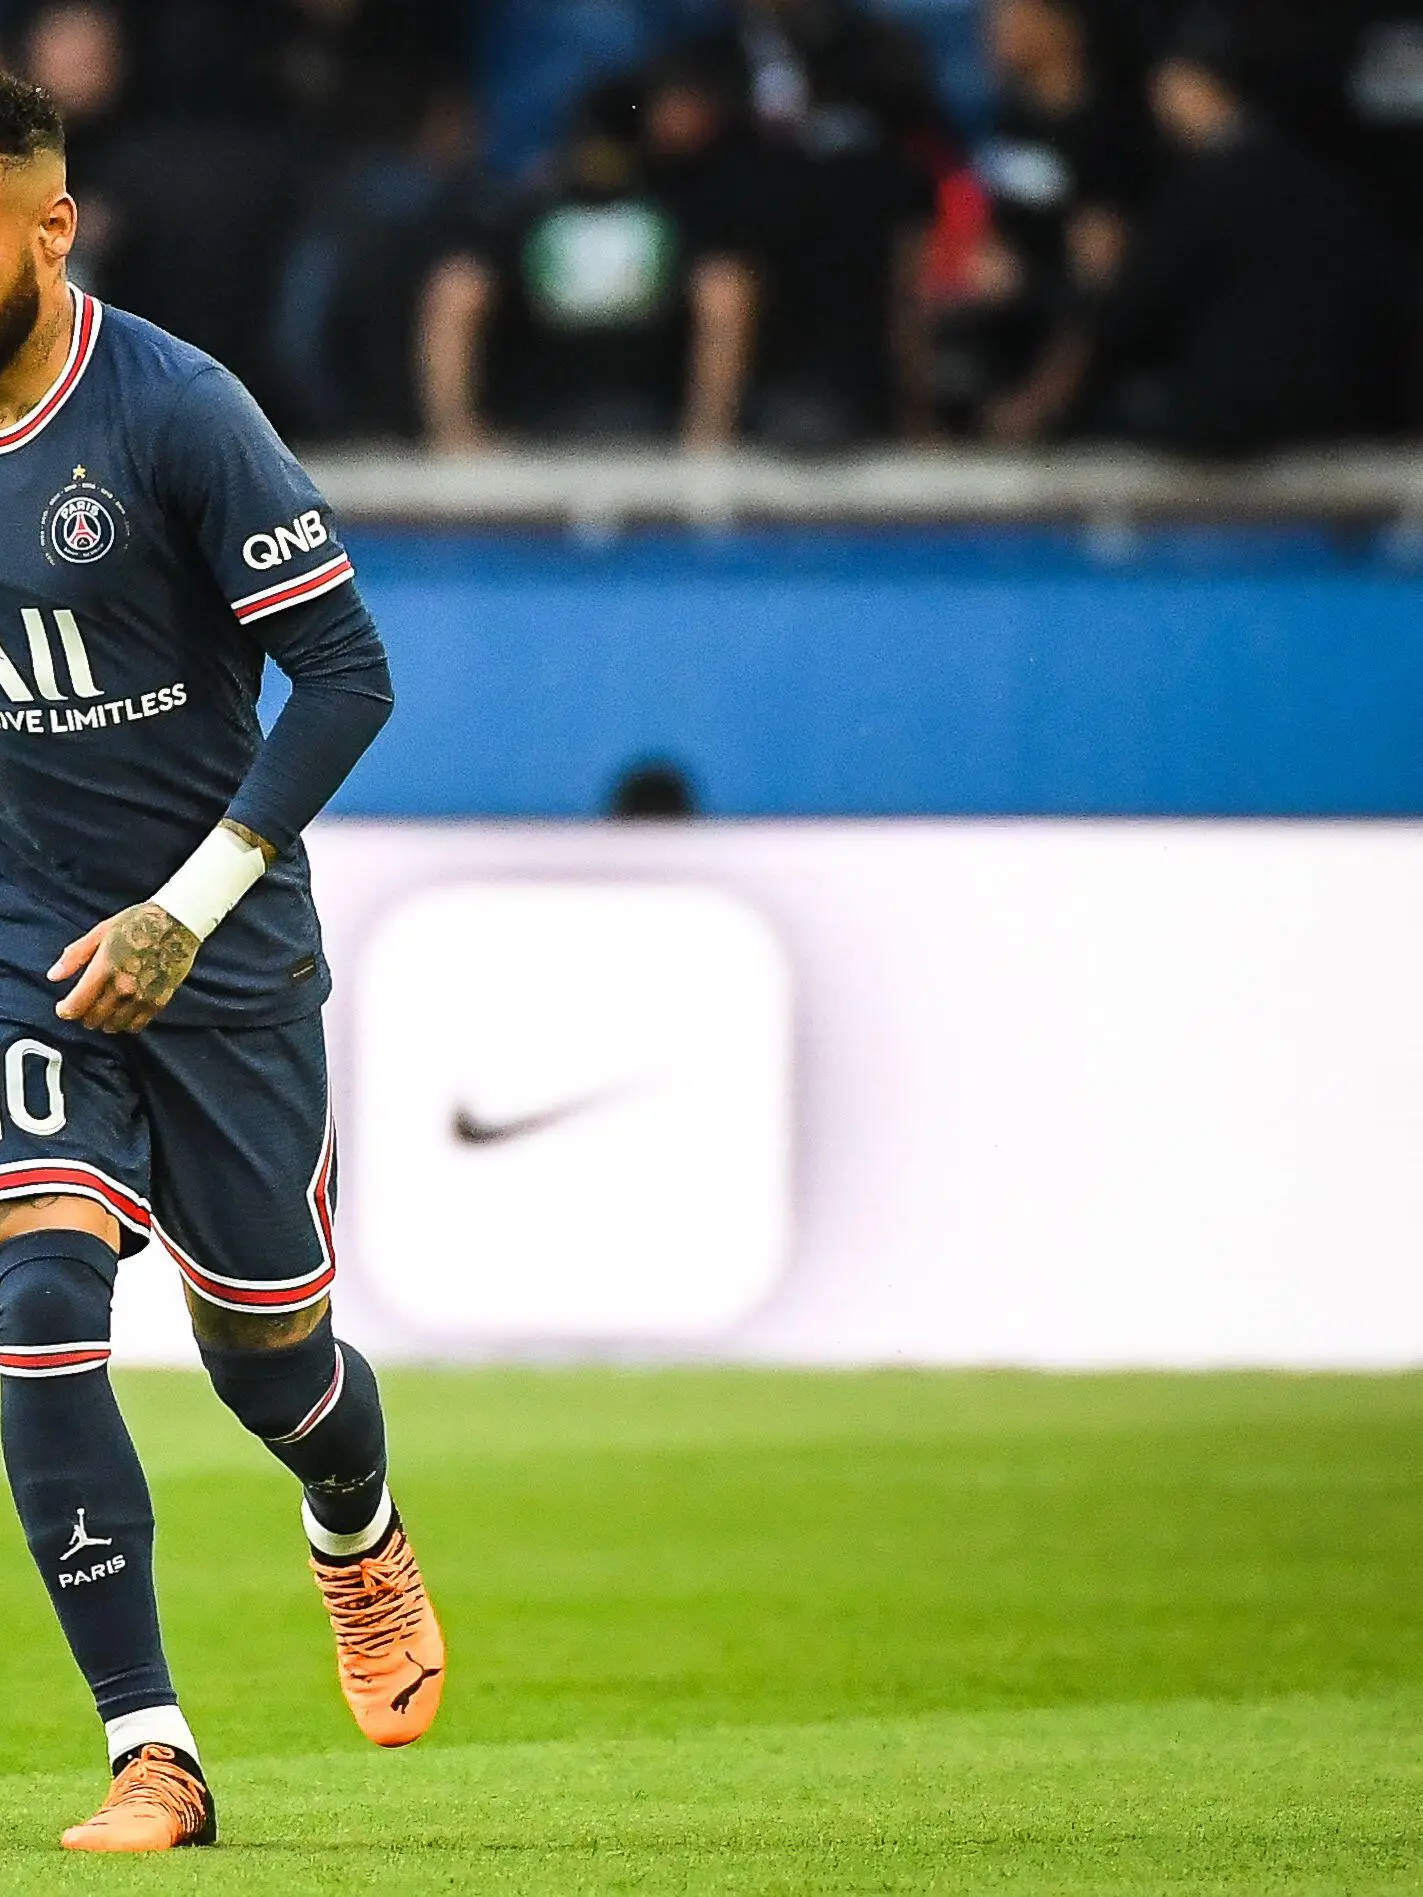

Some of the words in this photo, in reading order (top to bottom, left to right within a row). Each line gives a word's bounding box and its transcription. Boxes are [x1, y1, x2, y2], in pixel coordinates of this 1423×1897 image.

[60, 500, 100, 519] PARIS
[242, 510, 328, 570] QNB
[49, 683, 188, 734] LIMITLESS
[58, 1554, 127, 1589] PARIS
